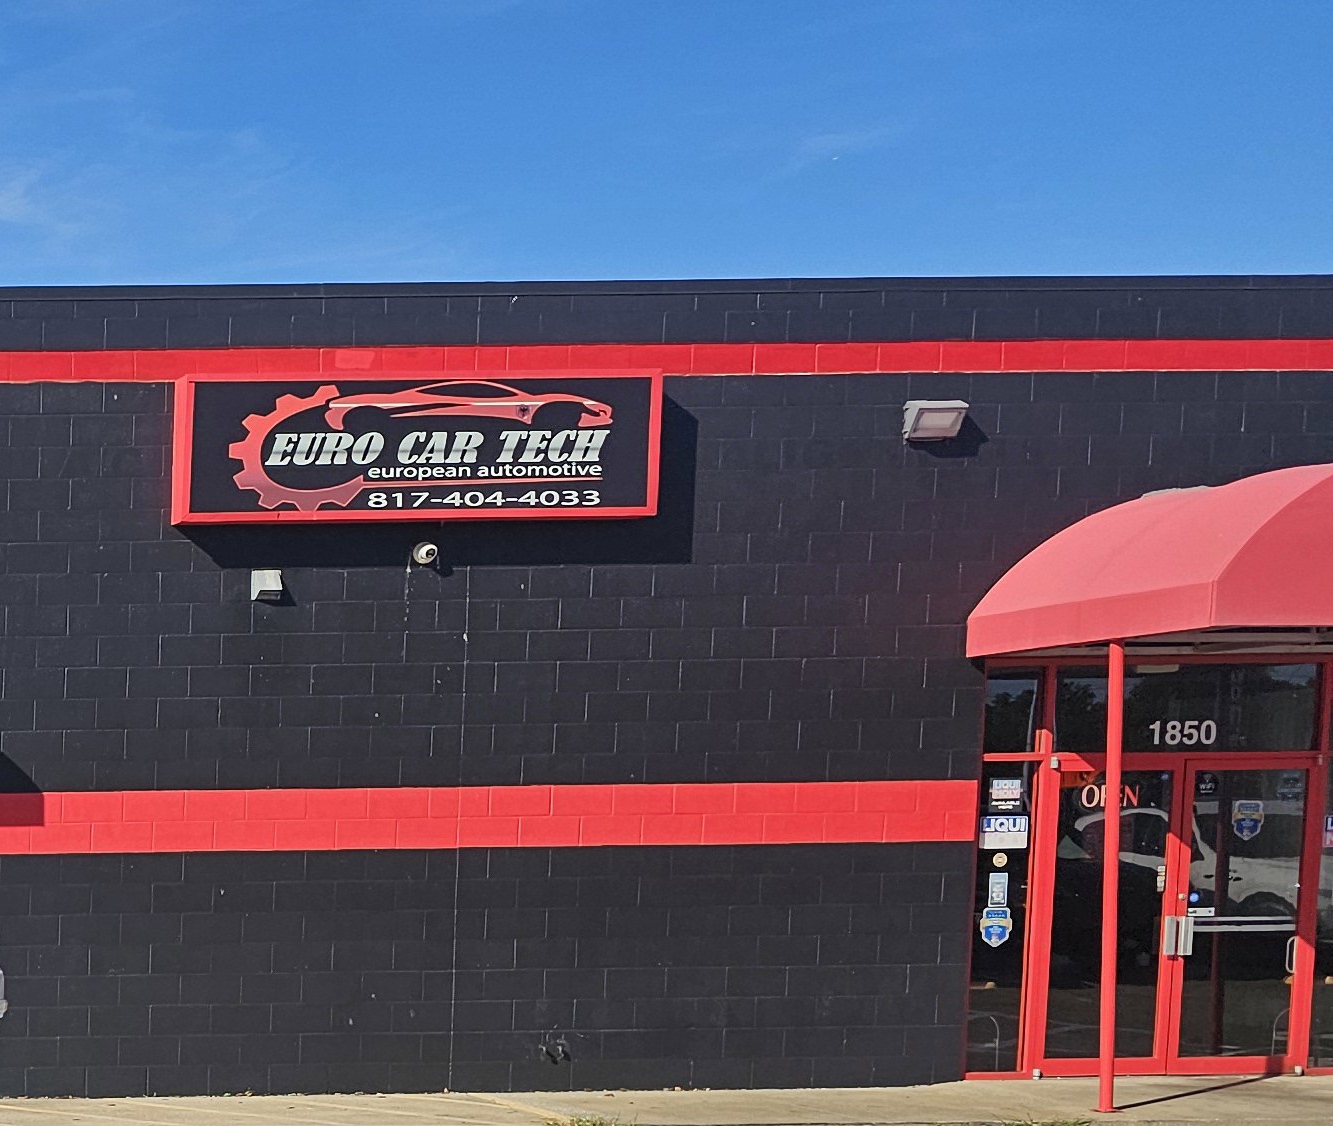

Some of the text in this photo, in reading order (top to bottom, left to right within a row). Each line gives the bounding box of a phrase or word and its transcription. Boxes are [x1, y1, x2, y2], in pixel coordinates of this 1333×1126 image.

[265, 430, 610, 466] EURO CAR TECH
[367, 462, 602, 480] european automotive
[367, 490, 601, 508] 817-404-4033
[1149, 720, 1217, 745] 1850
[1081, 784, 1139, 808] ON
